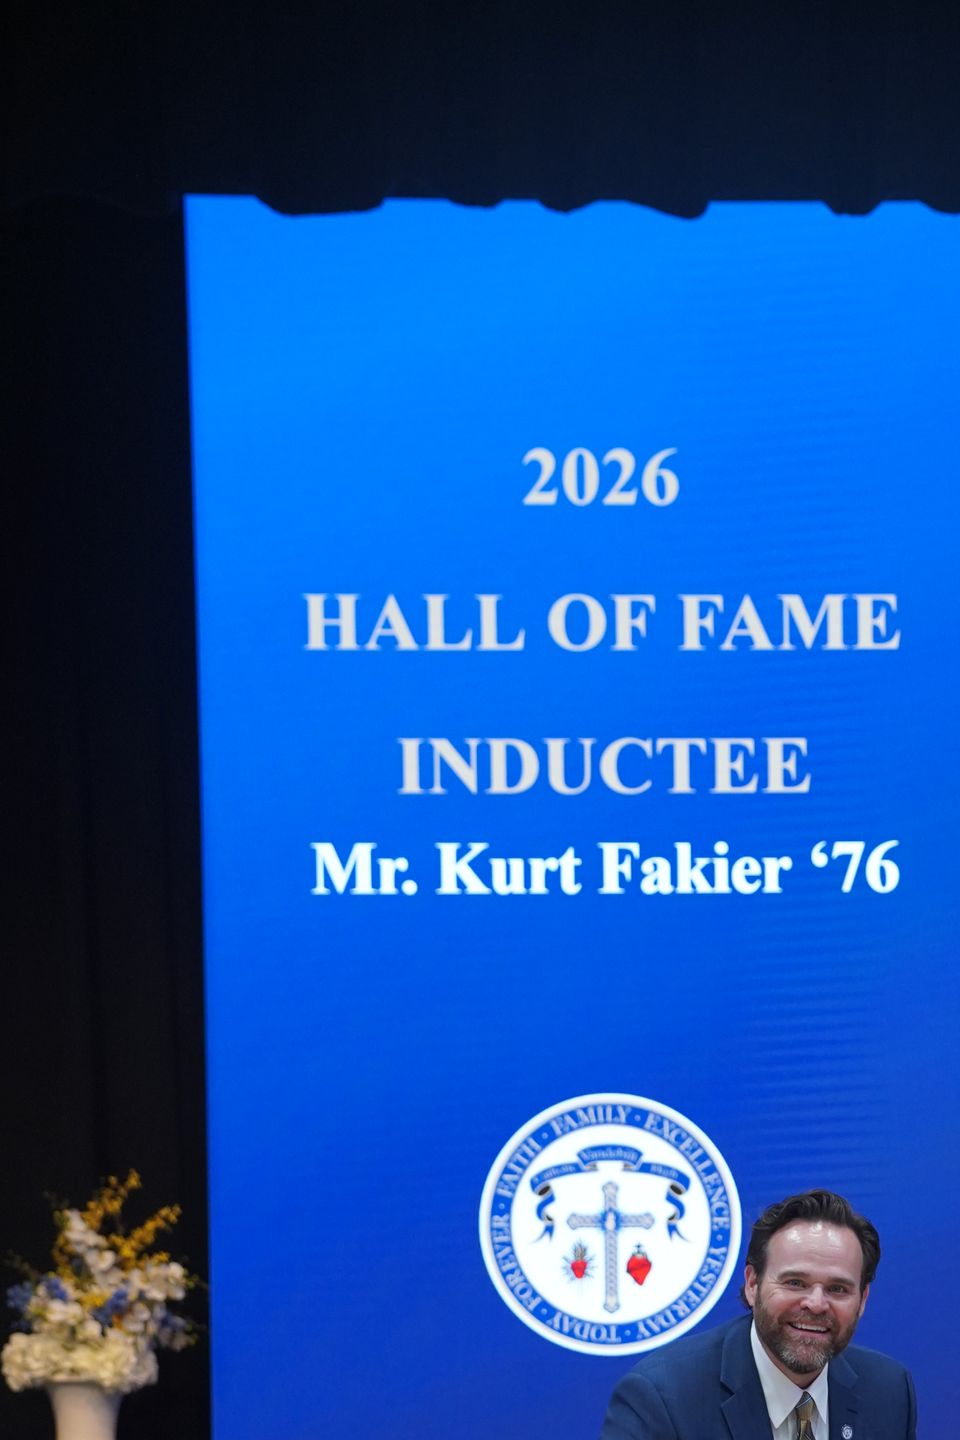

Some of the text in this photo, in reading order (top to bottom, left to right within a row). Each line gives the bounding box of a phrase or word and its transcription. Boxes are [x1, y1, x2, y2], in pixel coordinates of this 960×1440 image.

[523, 447, 680, 506] 2026
[305, 593, 901, 652] HALL OF FAME
[399, 737, 811, 795] INDUCTEE
[311, 842, 418, 896] Mr.
[436, 842, 583, 896] Kurt
[598, 840, 794, 895] Fakier
[549, 1103, 633, 1136] FAMILY
[496, 1136, 542, 1198] FAITH
[643, 1113, 731, 1231] EXCELLENCE
[491, 1212, 542, 1312] FOREVER
[635, 1245, 729, 1339] YESTERDAY
[546, 1312, 622, 1343] TODAY
